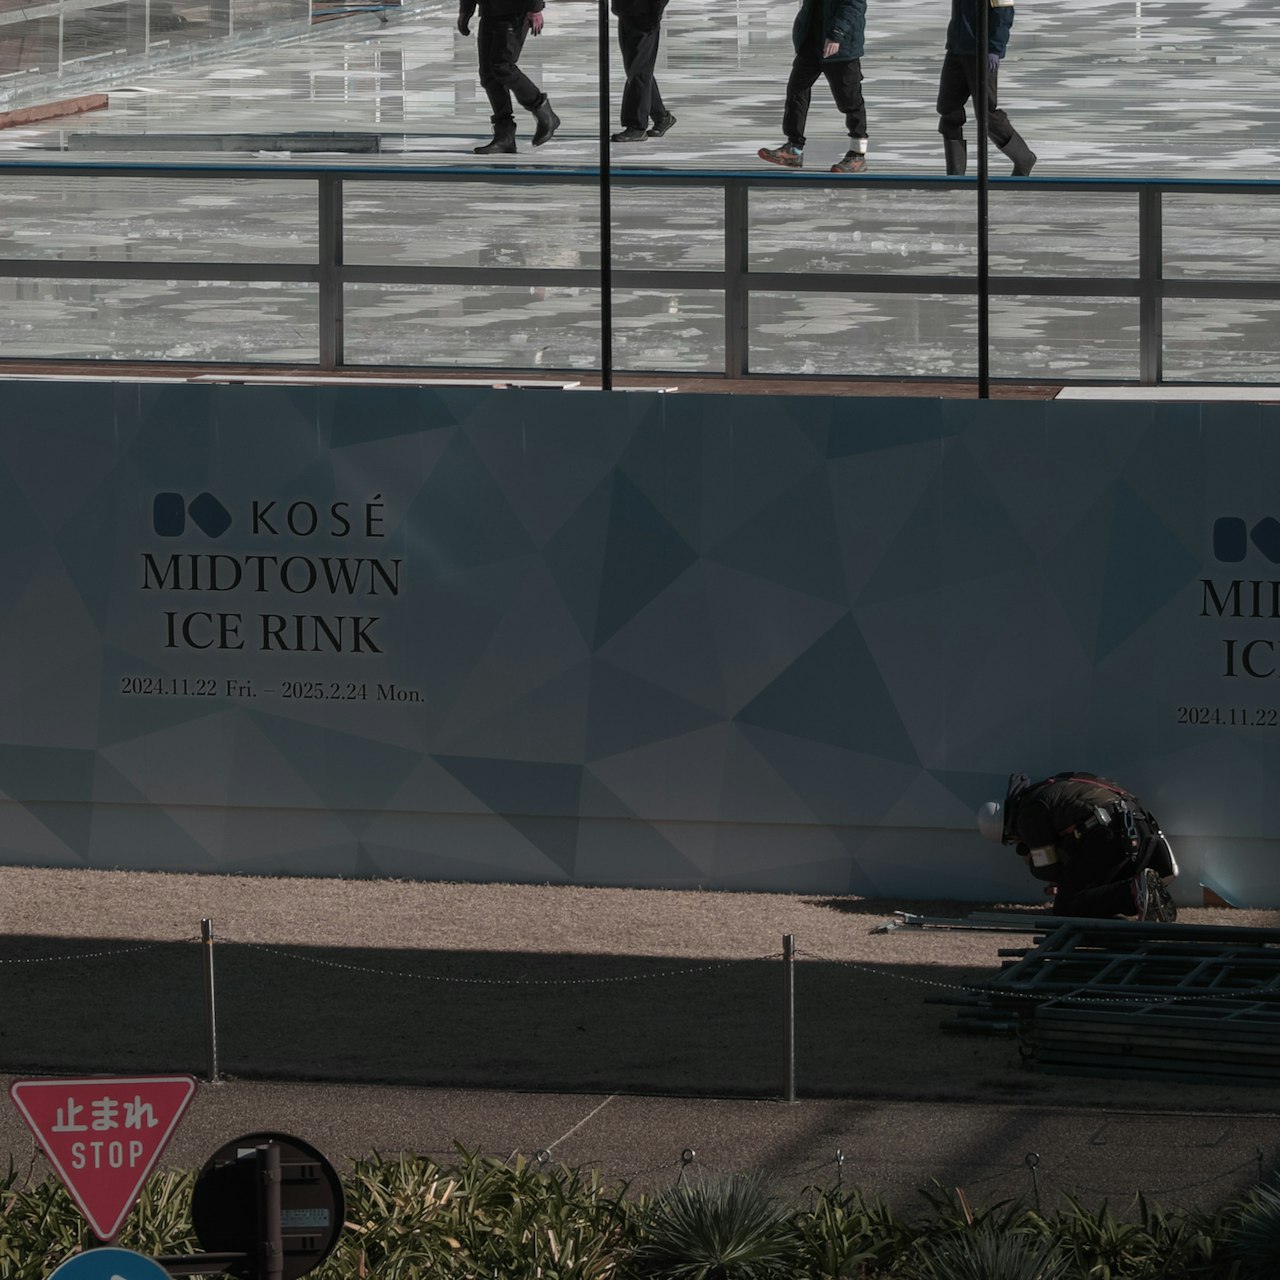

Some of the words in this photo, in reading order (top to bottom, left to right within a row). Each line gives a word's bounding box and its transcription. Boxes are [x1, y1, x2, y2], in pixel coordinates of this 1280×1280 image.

[253, 494, 384, 537] KOSÉ
[142, 554, 402, 595] MIDTOWN
[164, 612, 244, 649] ICE
[260, 615, 382, 653] RINK
[122, 678, 216, 695] 2024.11.22
[227, 680, 256, 696] Fri.
[282, 682, 366, 700] 2025.2.24
[377, 684, 424, 702] Mon.
[1178, 707, 1277, 726] 2024.11.22
[51, 1095, 158, 1132] 止まれ
[71, 1140, 144, 1169] STOP
